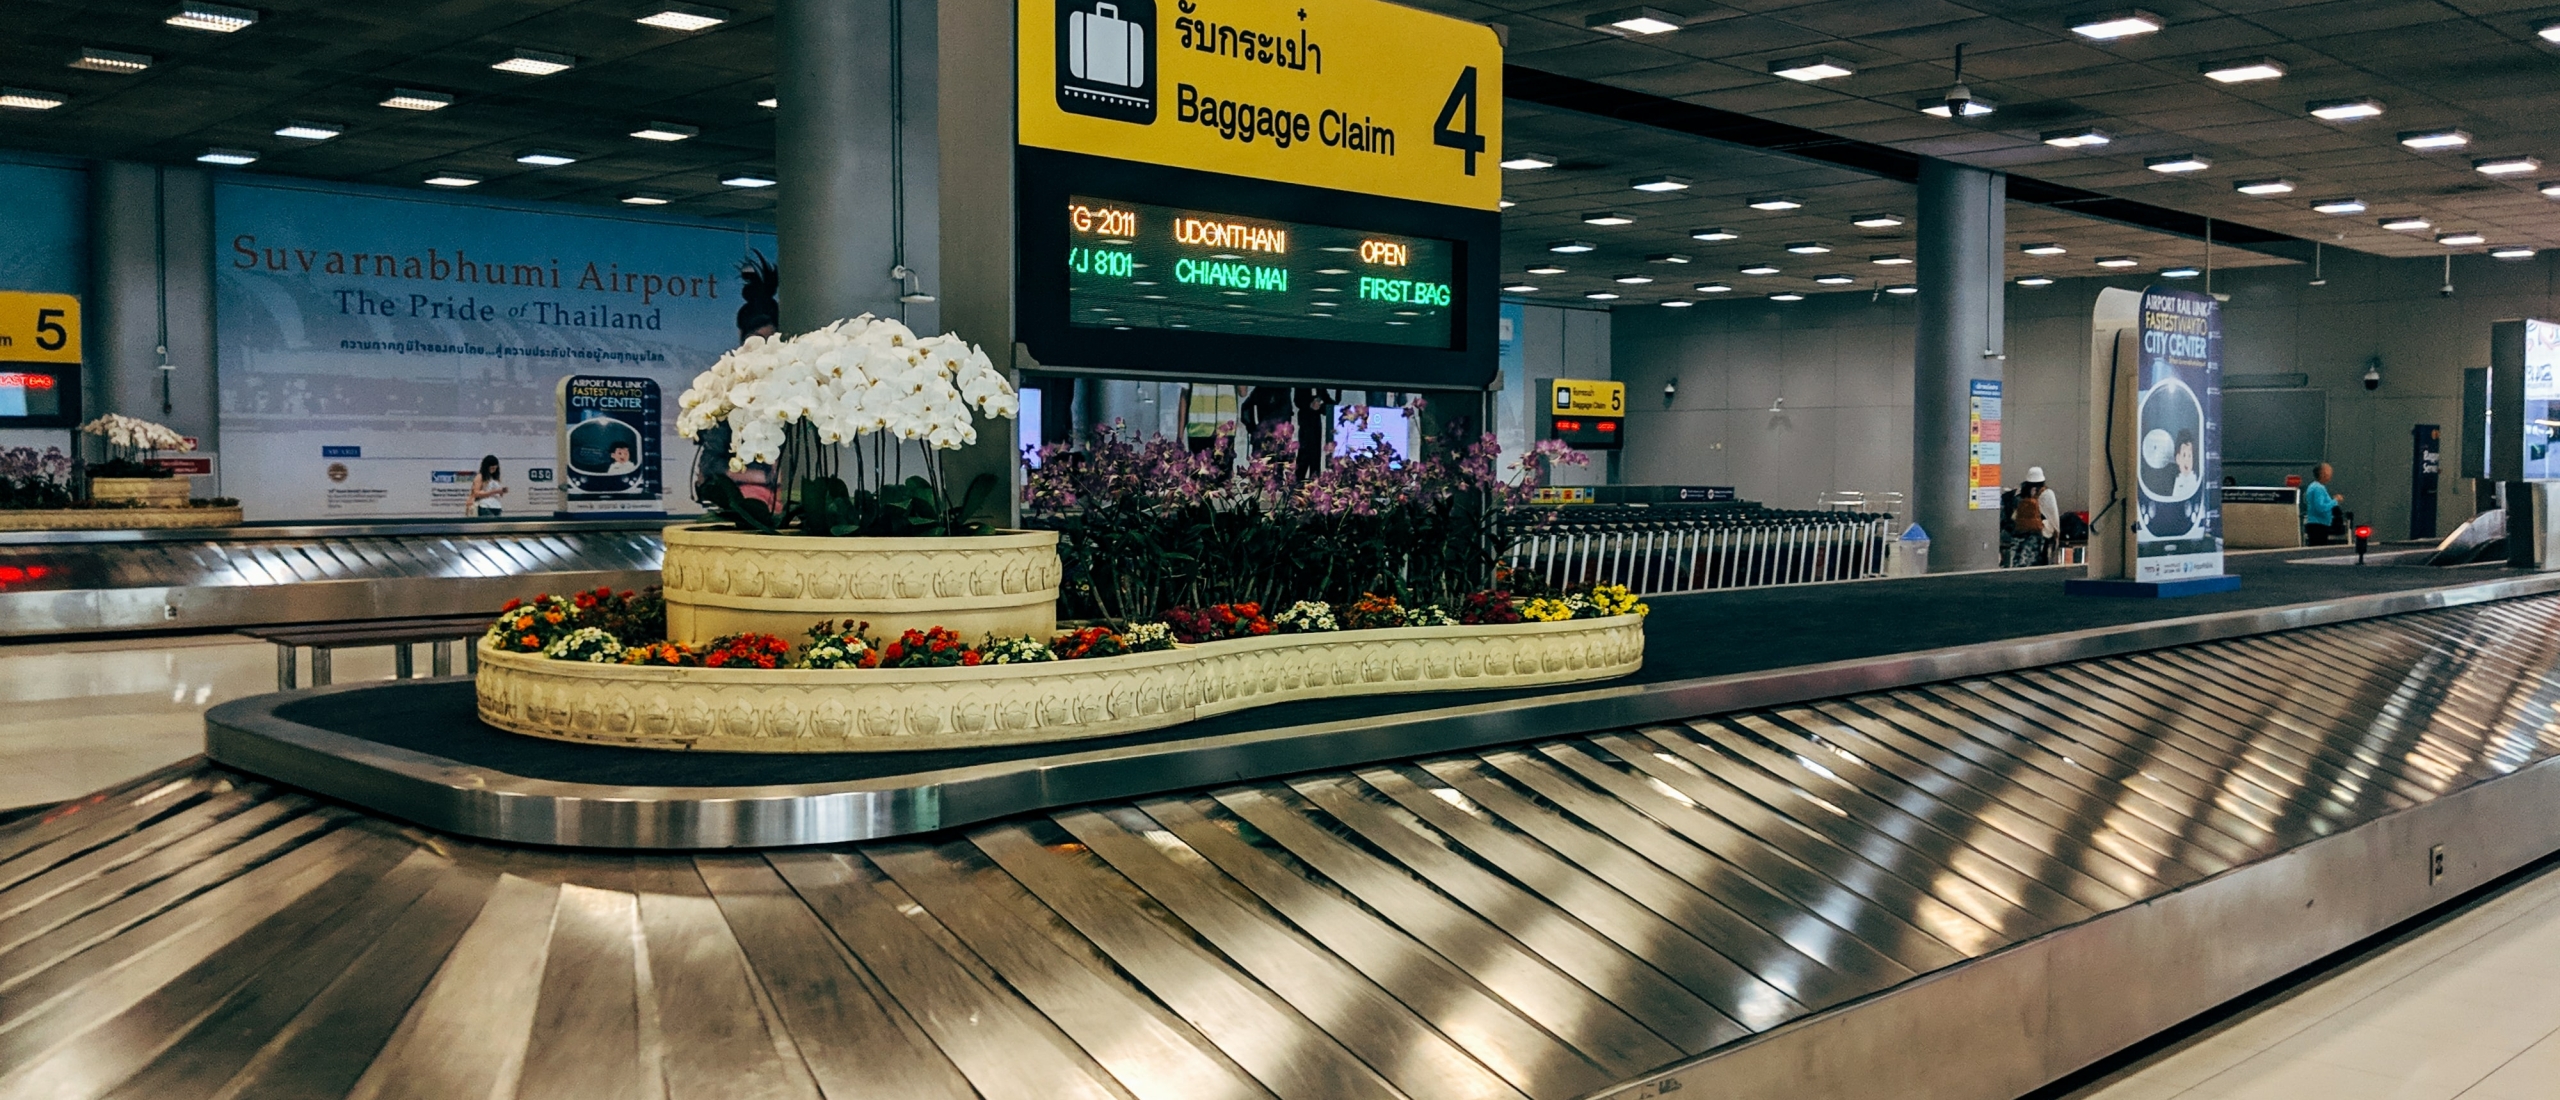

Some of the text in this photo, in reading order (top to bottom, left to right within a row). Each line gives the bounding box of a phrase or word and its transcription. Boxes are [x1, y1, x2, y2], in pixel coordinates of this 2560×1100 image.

[1175, 0, 1321, 74] รับกระเป๋า
[1177, 82, 1395, 156] Baggage Claim
[1434, 66, 1485, 176] 4
[1068, 205, 1407, 267] G 2011 UDONTHANI OPEN
[232, 233, 719, 305] Suvarnabhumi Airport
[1094, 250, 1132, 277] 8101
[1174, 258, 1251, 289] CHIANG
[1255, 266, 1288, 292] MAI
[1359, 276, 1412, 303] FIRST
[1414, 281, 1451, 306] BAG
[334, 289, 662, 331] The Pride of Thailand
[2146, 294, 2208, 317] AIRPORT RAIL LINK
[2146, 312, 2207, 336] FASTEST WAY TO
[35, 308, 67, 351] 5
[2145, 330, 2207, 358] CITY CENTER
[572, 396, 642, 408] CITY CENTER
[573, 388, 642, 397] FASTEST WAY TO
[606, 380, 623, 388] RAIL
[625, 381, 643, 389] LINK
[1612, 390, 1621, 411] 5
